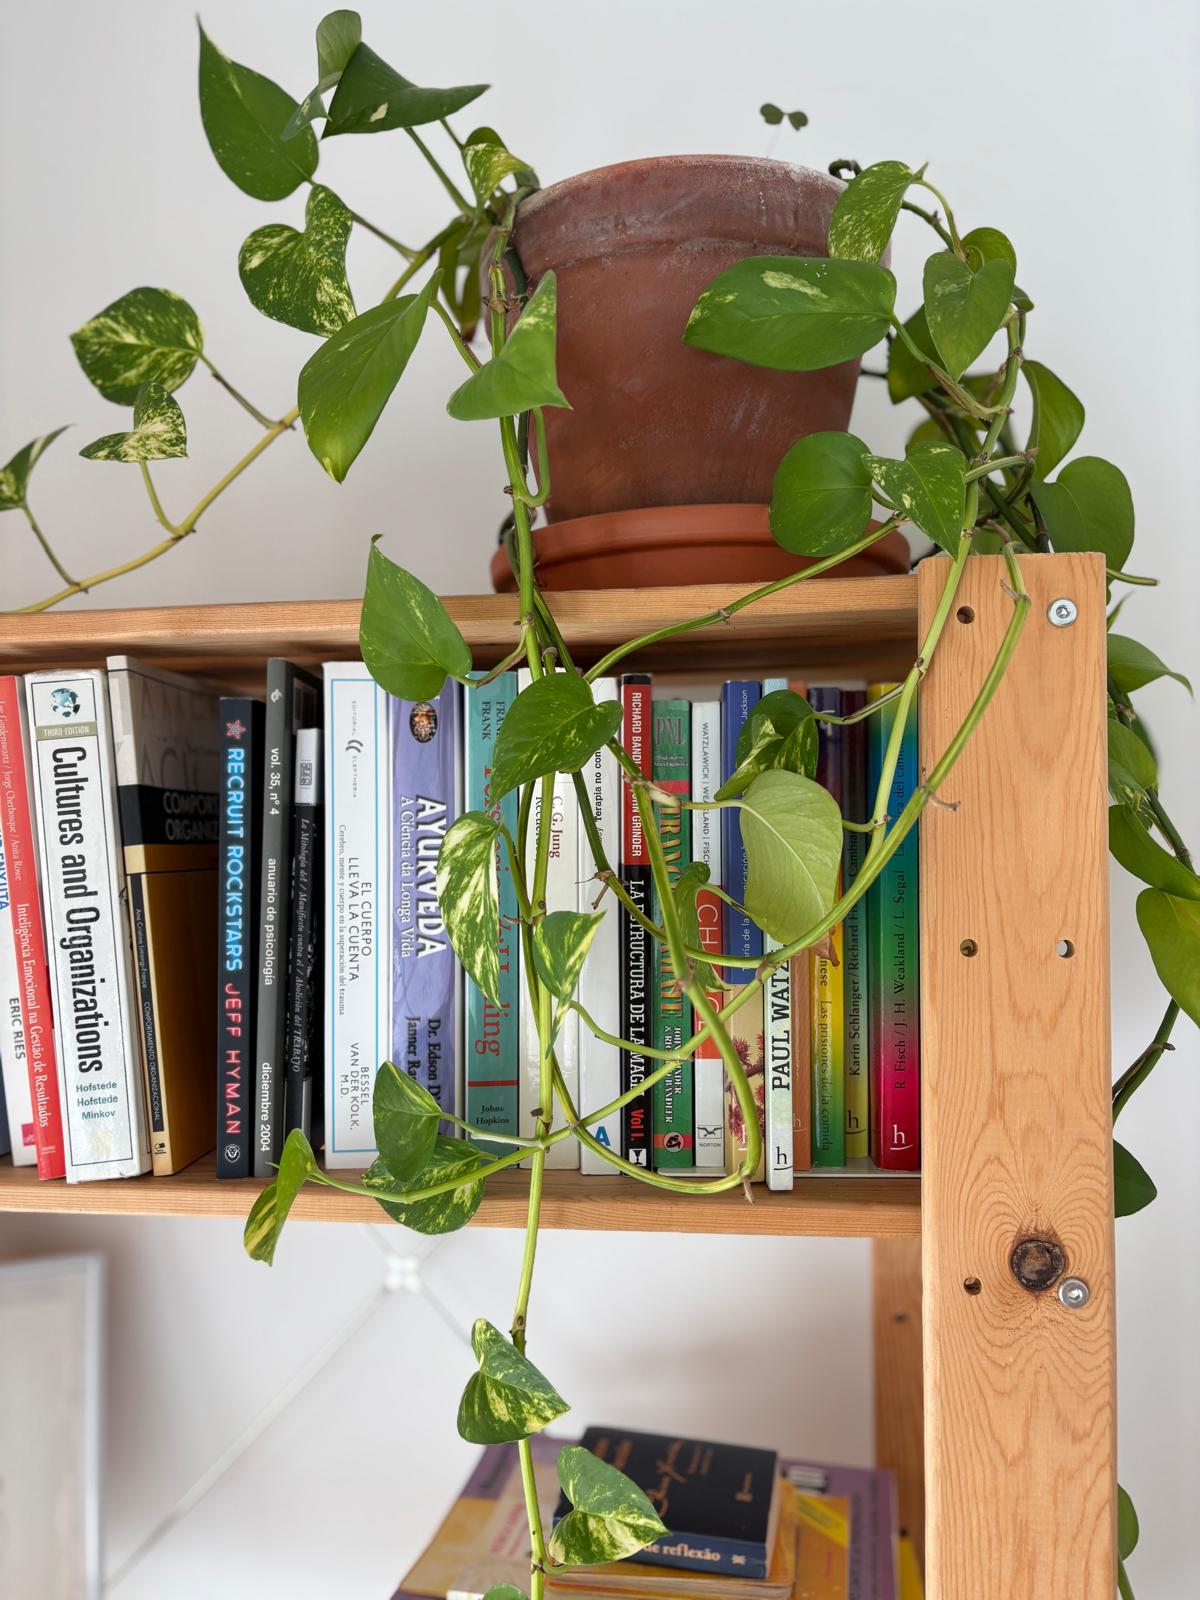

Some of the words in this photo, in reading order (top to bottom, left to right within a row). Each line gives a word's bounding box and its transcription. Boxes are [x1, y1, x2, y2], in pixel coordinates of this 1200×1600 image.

[631, 692, 642, 733] RICHARD
[740, 689, 749, 720] Jackson
[44, 728, 63, 737] THIRD
[64, 725, 90, 736] EDITION
[482, 701, 491, 740] FRANK
[270, 747, 280, 768] vol.
[701, 722, 710, 779] WATZLAWICK
[2, 770, 15, 789] Jorge
[268, 772, 280, 790] 35,
[595, 772, 603, 784] no
[893, 781, 905, 798] del
[52, 746, 89, 847] Cultures
[226, 748, 245, 839] RECRUIT
[402, 796, 413, 806] A
[552, 796, 564, 809] C.
[594, 787, 605, 822] Terapia
[6, 789, 18, 833] Cherbosque
[269, 807, 279, 816] 4
[301, 818, 310, 829] La
[552, 812, 564, 827] G.
[338, 824, 347, 856] Cerebro,
[401, 811, 415, 858] Ciência
[549, 828, 564, 859] Jung
[631, 815, 642, 857] GRINDER
[11, 838, 21, 860] Anita
[12, 860, 23, 881] Rowe
[61, 853, 98, 899] and
[267, 858, 278, 903] anuario
[300, 869, 309, 882] del
[348, 857, 360, 899] LLEVA
[401, 862, 415, 877] da
[417, 796, 448, 958] AYURVEDA
[337, 888, 345, 914] cuerpo
[361, 882, 372, 896] EL
[630, 880, 644, 900] LA
[893, 870, 906, 904] Segal
[225, 845, 244, 971] ROCKSTARS
[266, 906, 277, 921] de
[296, 891, 307, 932] Manifiesto
[348, 903, 360, 921] LA
[397, 882, 414, 923] Longa
[893, 909, 905, 920] L.
[16, 902, 34, 959] Inteligência
[361, 900, 372, 957] CUERPO
[740, 918, 750, 926] la
[740, 929, 750, 941] de
[262, 924, 276, 986] psicología
[296, 933, 304, 957] contra
[337, 934, 347, 974] superación
[348, 925, 360, 981] CUENTA
[401, 928, 414, 958] Vida
[847, 924, 860, 970] Richard
[893, 933, 906, 994] Weakland
[23, 958, 40, 1010] Emocional
[60, 906, 109, 1074] Organizations
[294, 976, 304, 1012] Abolición
[339, 975, 347, 986] del
[9, 998, 22, 1026] ERIC
[28, 1011, 39, 1025] na
[224, 983, 242, 1037] JEFF
[293, 1014, 302, 1026] del
[630, 1003, 644, 1023] DE
[820, 1000, 833, 1019] Las
[848, 980, 862, 1040] Schlanger
[894, 1000, 906, 1013] H.
[144, 1001, 156, 1060] COMPORTAMENTO
[405, 1015, 421, 1056] Janner
[428, 1018, 441, 1038] Dr.
[630, 1026, 644, 1046] LA
[894, 1018, 908, 1027] J.
[13, 1030, 26, 1060] RIES
[30, 1025, 44, 1060] Gestão
[291, 1029, 301, 1072] TRABAJO
[350, 1042, 360, 1066] VAN
[818, 1023, 833, 1074] prisiones
[894, 1040, 906, 1072] Fisch
[33, 1060, 46, 1073] de
[428, 1042, 441, 1081] Edson
[771, 1030, 790, 1091] PAUL
[848, 1044, 860, 1076] Karin
[76, 1081, 118, 1093] Hofstede
[149, 1061, 160, 1122] ORGANIZACIONAL
[224, 1049, 242, 1134] HYMAN
[260, 1062, 272, 1121] diciembre
[340, 1074, 350, 1099] M.D.
[350, 1070, 360, 1093] DER
[360, 1066, 370, 1106] BESSEL
[820, 1077, 833, 1090] de
[35, 1073, 52, 1128] Resultados
[77, 1094, 119, 1107] Hofstede
[348, 1096, 360, 1130] KOLK,
[481, 1104, 504, 1113] Johns
[664, 1079, 673, 1123] BANDLER
[820, 1094, 833, 1105] la
[82, 1109, 116, 1121] Minkov
[475, 1116, 510, 1126] Hopkins
[630, 1109, 645, 1129] Vol
[848, 1109, 859, 1129] h
[260, 1124, 272, 1152] 2004
[892, 1123, 906, 1145] h
[776, 1146, 787, 1165] h
[661, 1542, 721, 1562] reflexão
